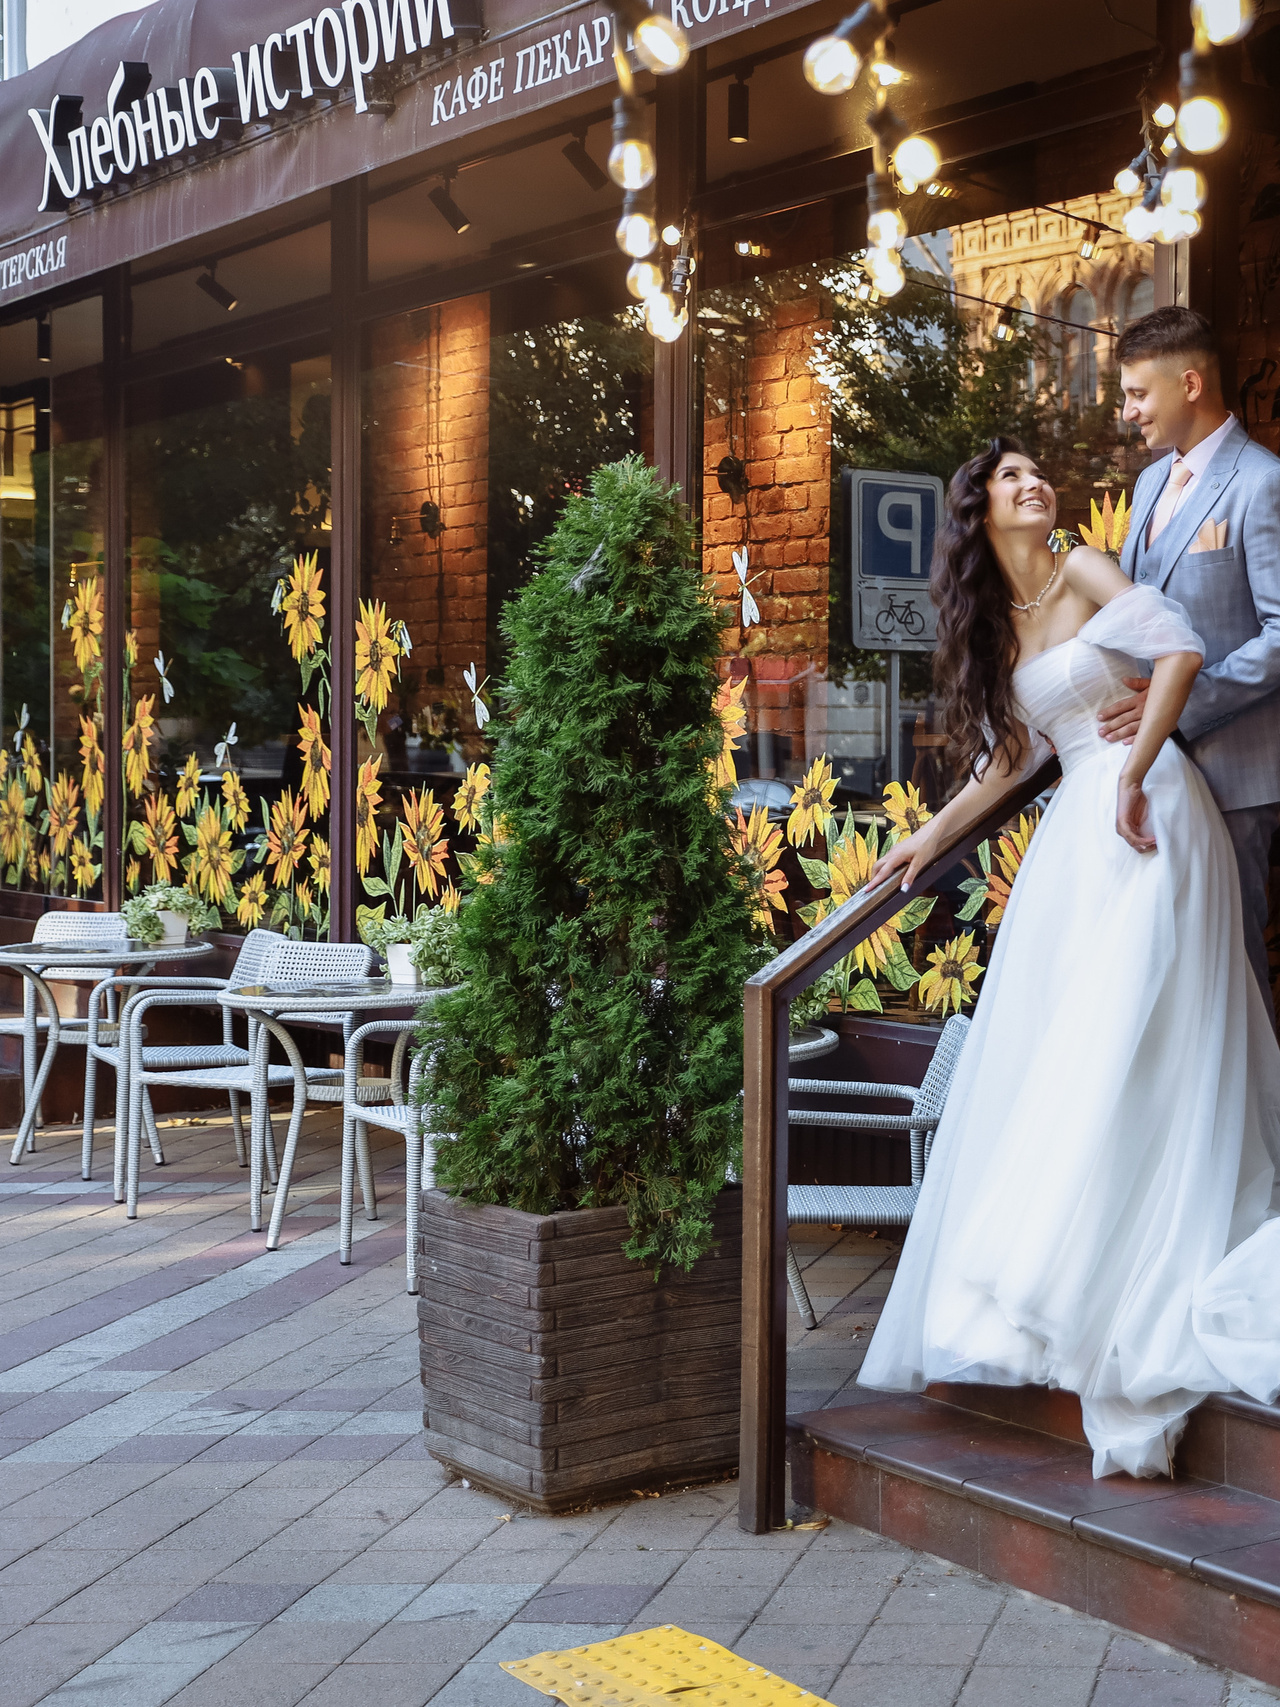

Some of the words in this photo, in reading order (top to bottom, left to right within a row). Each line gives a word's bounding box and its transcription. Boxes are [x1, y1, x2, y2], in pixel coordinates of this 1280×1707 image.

[430, 58, 506, 127] КАФЕ
[513, 2, 653, 94] ПЕКАР
[28, 61, 219, 212] Хлебные
